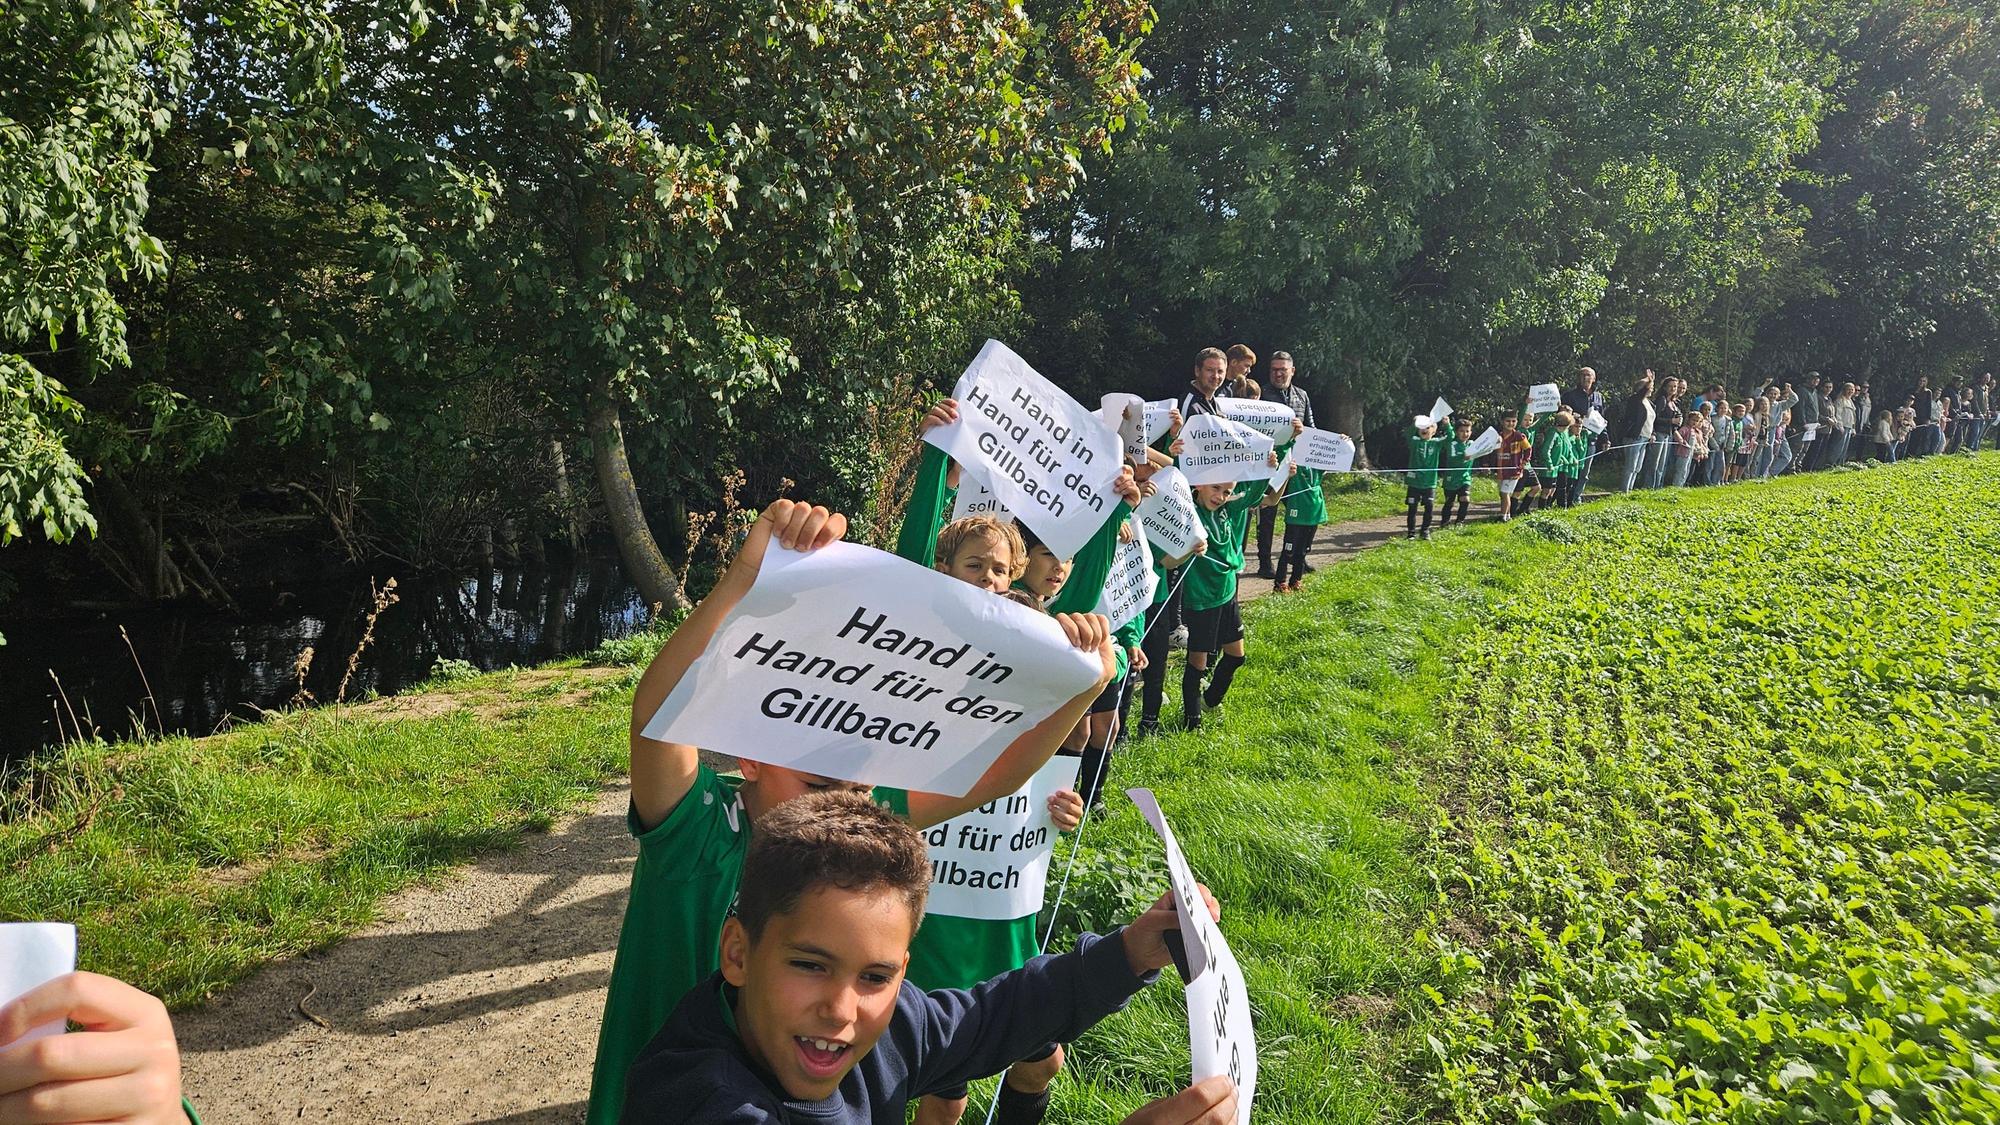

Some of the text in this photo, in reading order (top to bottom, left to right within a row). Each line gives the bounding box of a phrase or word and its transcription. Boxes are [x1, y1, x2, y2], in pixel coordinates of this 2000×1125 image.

[1011, 387, 1094, 465] Hand in
[1249, 415, 1263, 424] für
[1253, 428, 1275, 437] Han
[1264, 416, 1291, 426] Hand
[1190, 430, 1218, 440] Viele
[1204, 443, 1221, 452] ein
[1313, 435, 1340, 446] Gillbach
[966, 386, 1104, 513] Hand für den
[1185, 454, 1231, 467] Gillbach
[1234, 452, 1264, 463] bleibt
[1305, 457, 1336, 466] gestalten
[1310, 450, 1336, 460] Zukunft
[978, 432, 1065, 518] Gillbach
[968, 500, 997, 513] soll
[1142, 516, 1186, 549] gestalten
[1157, 507, 1191, 535] Zukunft
[1112, 568, 1149, 602] Zukunft
[837, 606, 1014, 685] Hand in
[734, 632, 1024, 725] Hand für den
[760, 687, 941, 751] Gillbach
[958, 825, 1002, 852] für
[1009, 826, 1047, 851] den
[931, 859, 1020, 890] llbach
